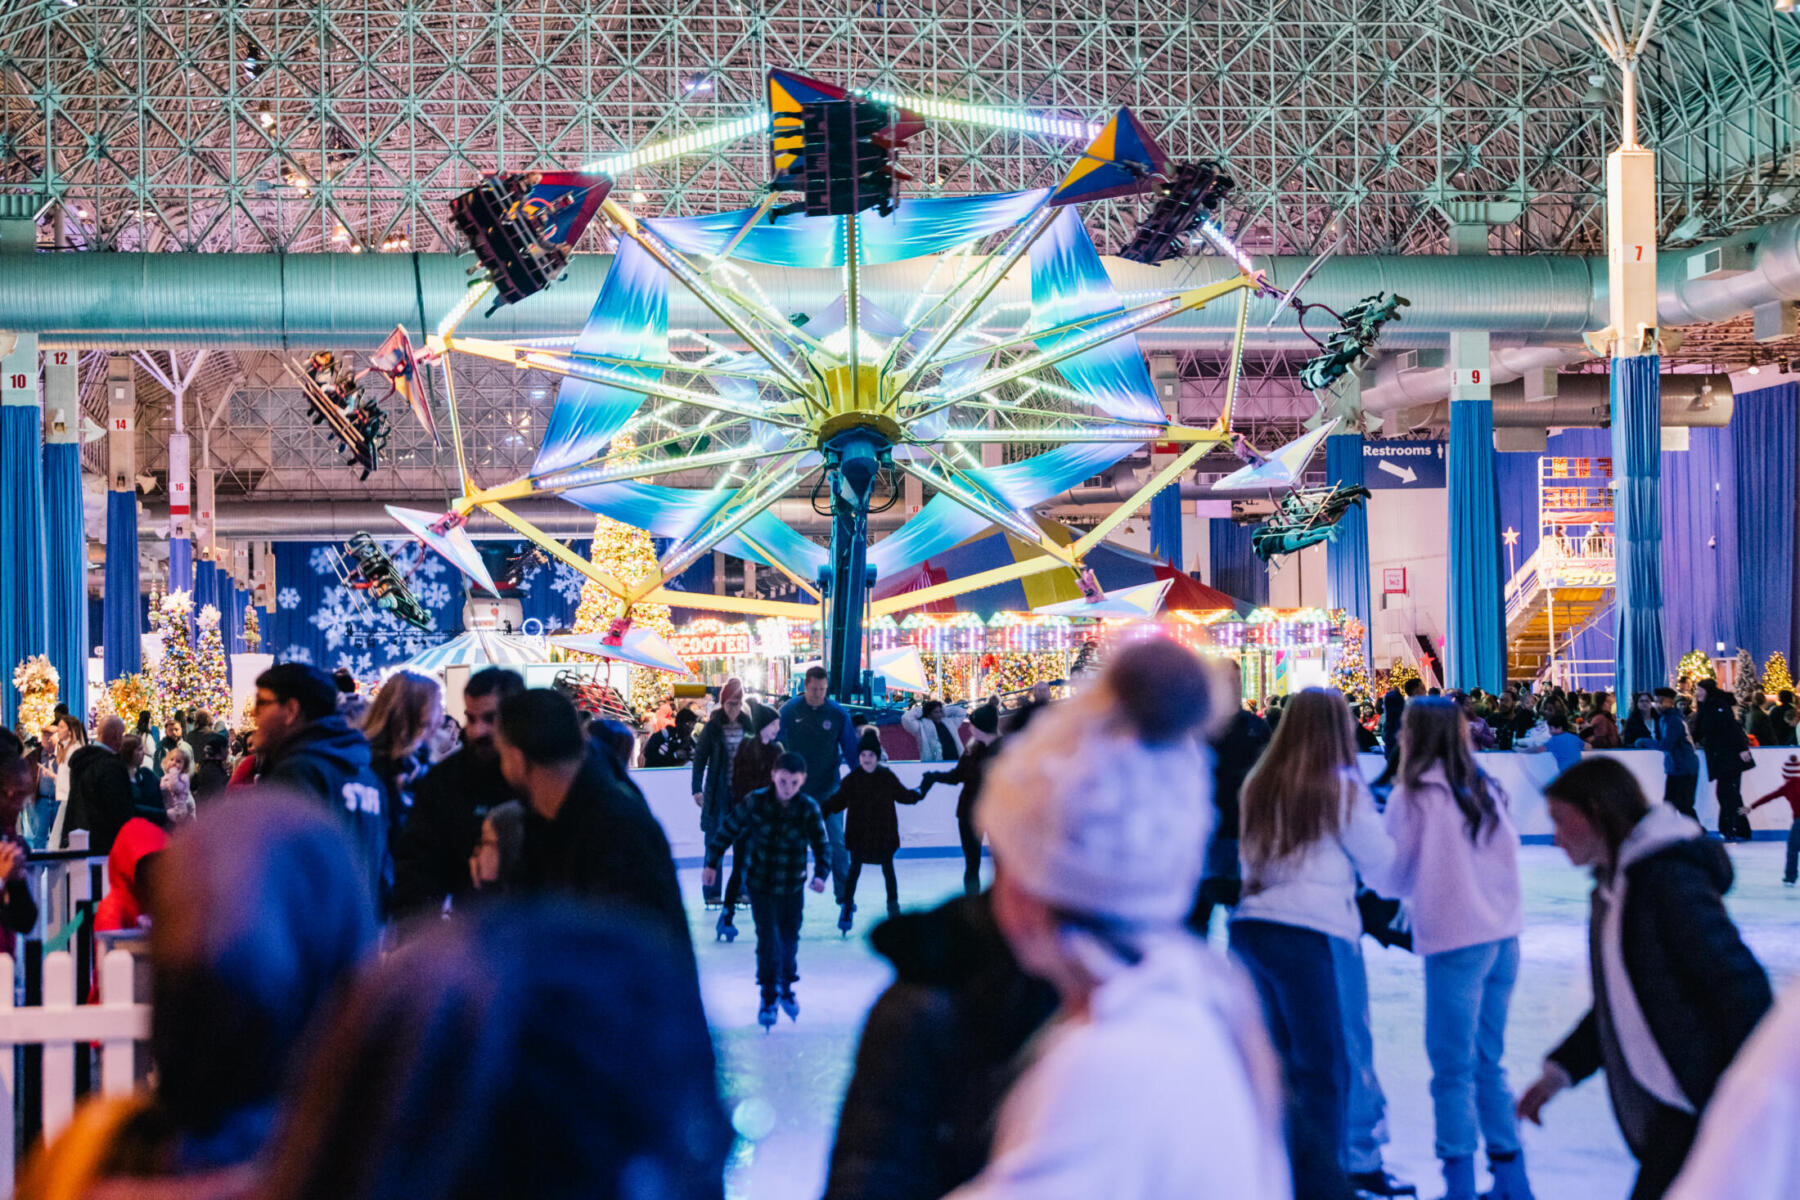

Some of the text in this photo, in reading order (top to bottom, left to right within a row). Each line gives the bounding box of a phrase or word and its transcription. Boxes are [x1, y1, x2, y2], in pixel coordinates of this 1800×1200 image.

[1635, 245, 1643, 261] 7
[54, 352, 68, 365] 12
[10, 374, 26, 389] 10
[1471, 369, 1480, 384] 9
[116, 419, 127, 430] 14
[1362, 445, 1432, 456] Restrooms
[175, 482, 184, 492] 16
